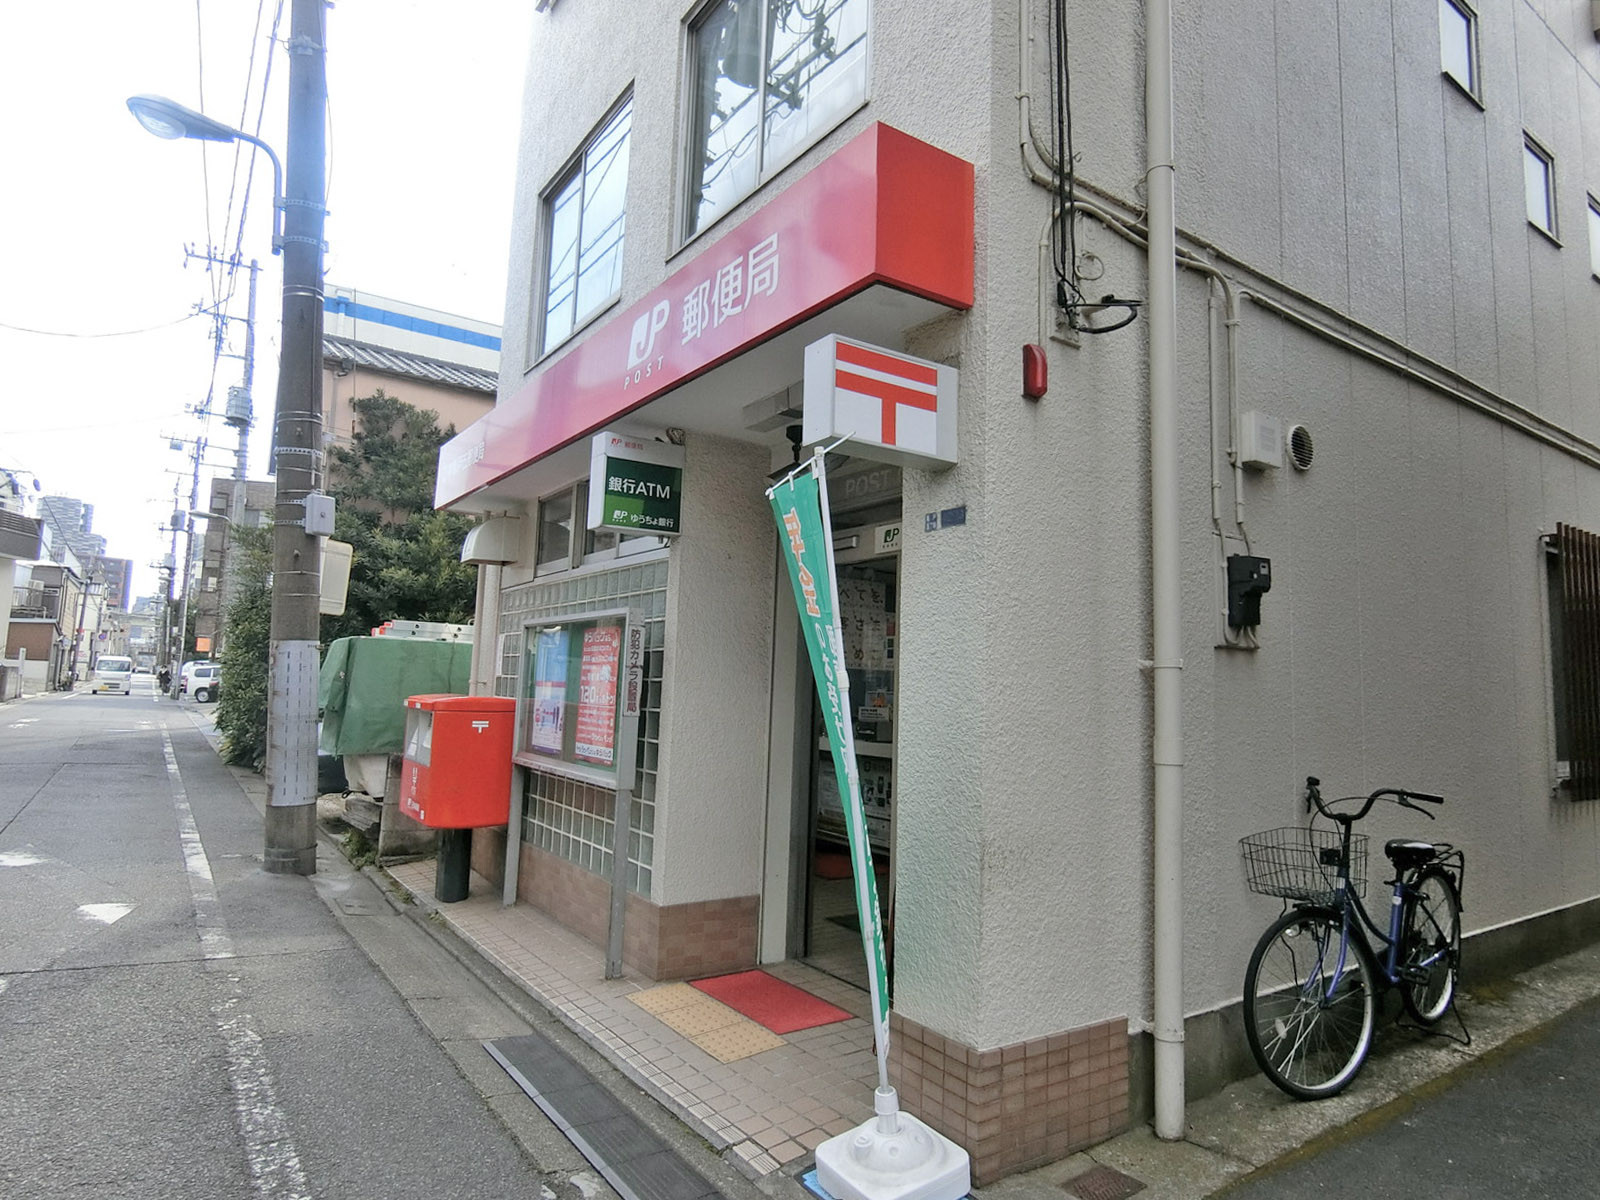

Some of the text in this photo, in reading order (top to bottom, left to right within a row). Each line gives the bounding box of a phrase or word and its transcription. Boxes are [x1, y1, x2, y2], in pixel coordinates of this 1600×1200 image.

[681, 232, 779, 346] 郵便局
[623, 355, 664, 390] POST
[608, 476, 671, 500] 銀行ATM
[846, 470, 890, 496] POST
[630, 513, 674, 528] ゆうちょ銀行
